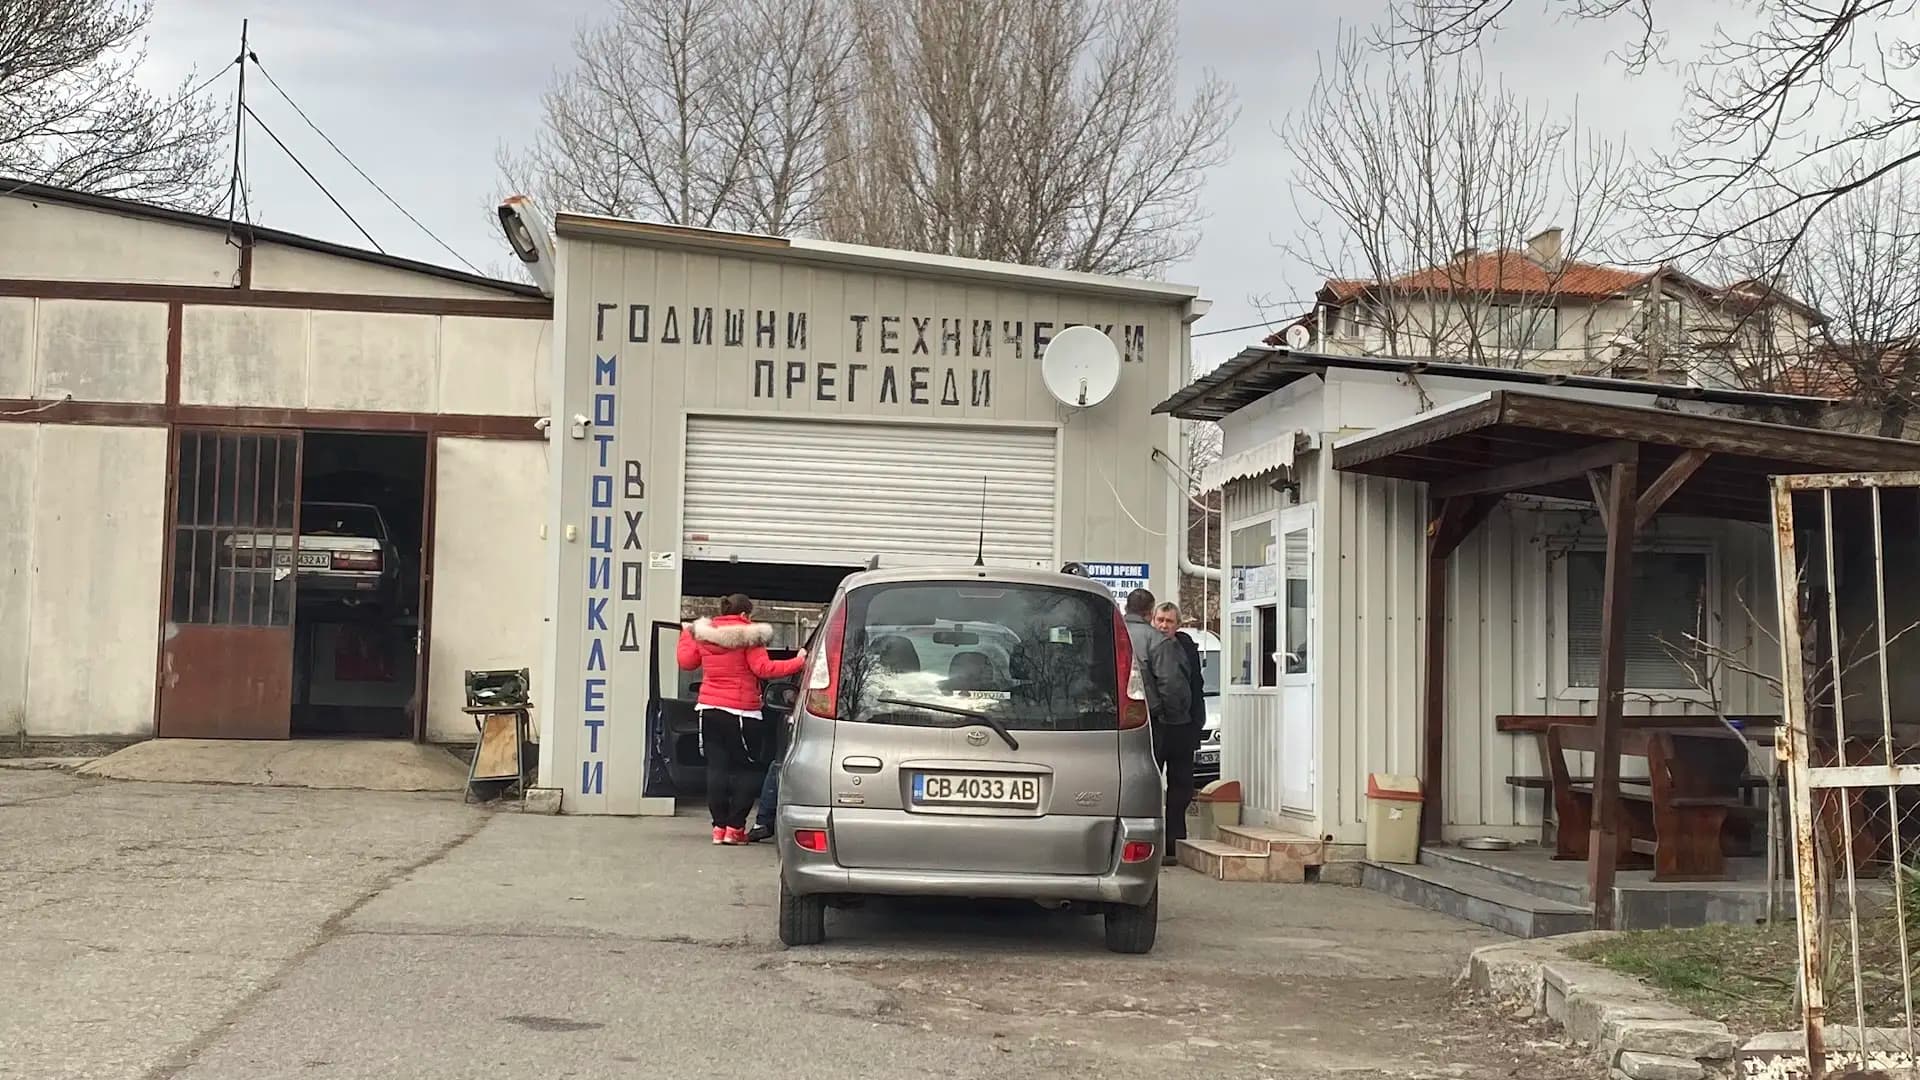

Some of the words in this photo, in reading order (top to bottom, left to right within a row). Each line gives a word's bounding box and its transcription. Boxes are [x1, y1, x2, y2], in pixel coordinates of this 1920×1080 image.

[596, 303, 807, 351] ГОДИШНИ
[850, 313, 1145, 363] ТЕХНИЧЕИ
[754, 359, 991, 408] ПРЕГЛЕДИ
[581, 353, 616, 796] МОТОЦИКЛЕТИ
[619, 460, 645, 652] ВХОД
[1113, 565, 1143, 577] ВРЕМЕ
[926, 778, 952, 798] CB
[956, 778, 1004, 799] 4033
[1009, 780, 1034, 800] AB
